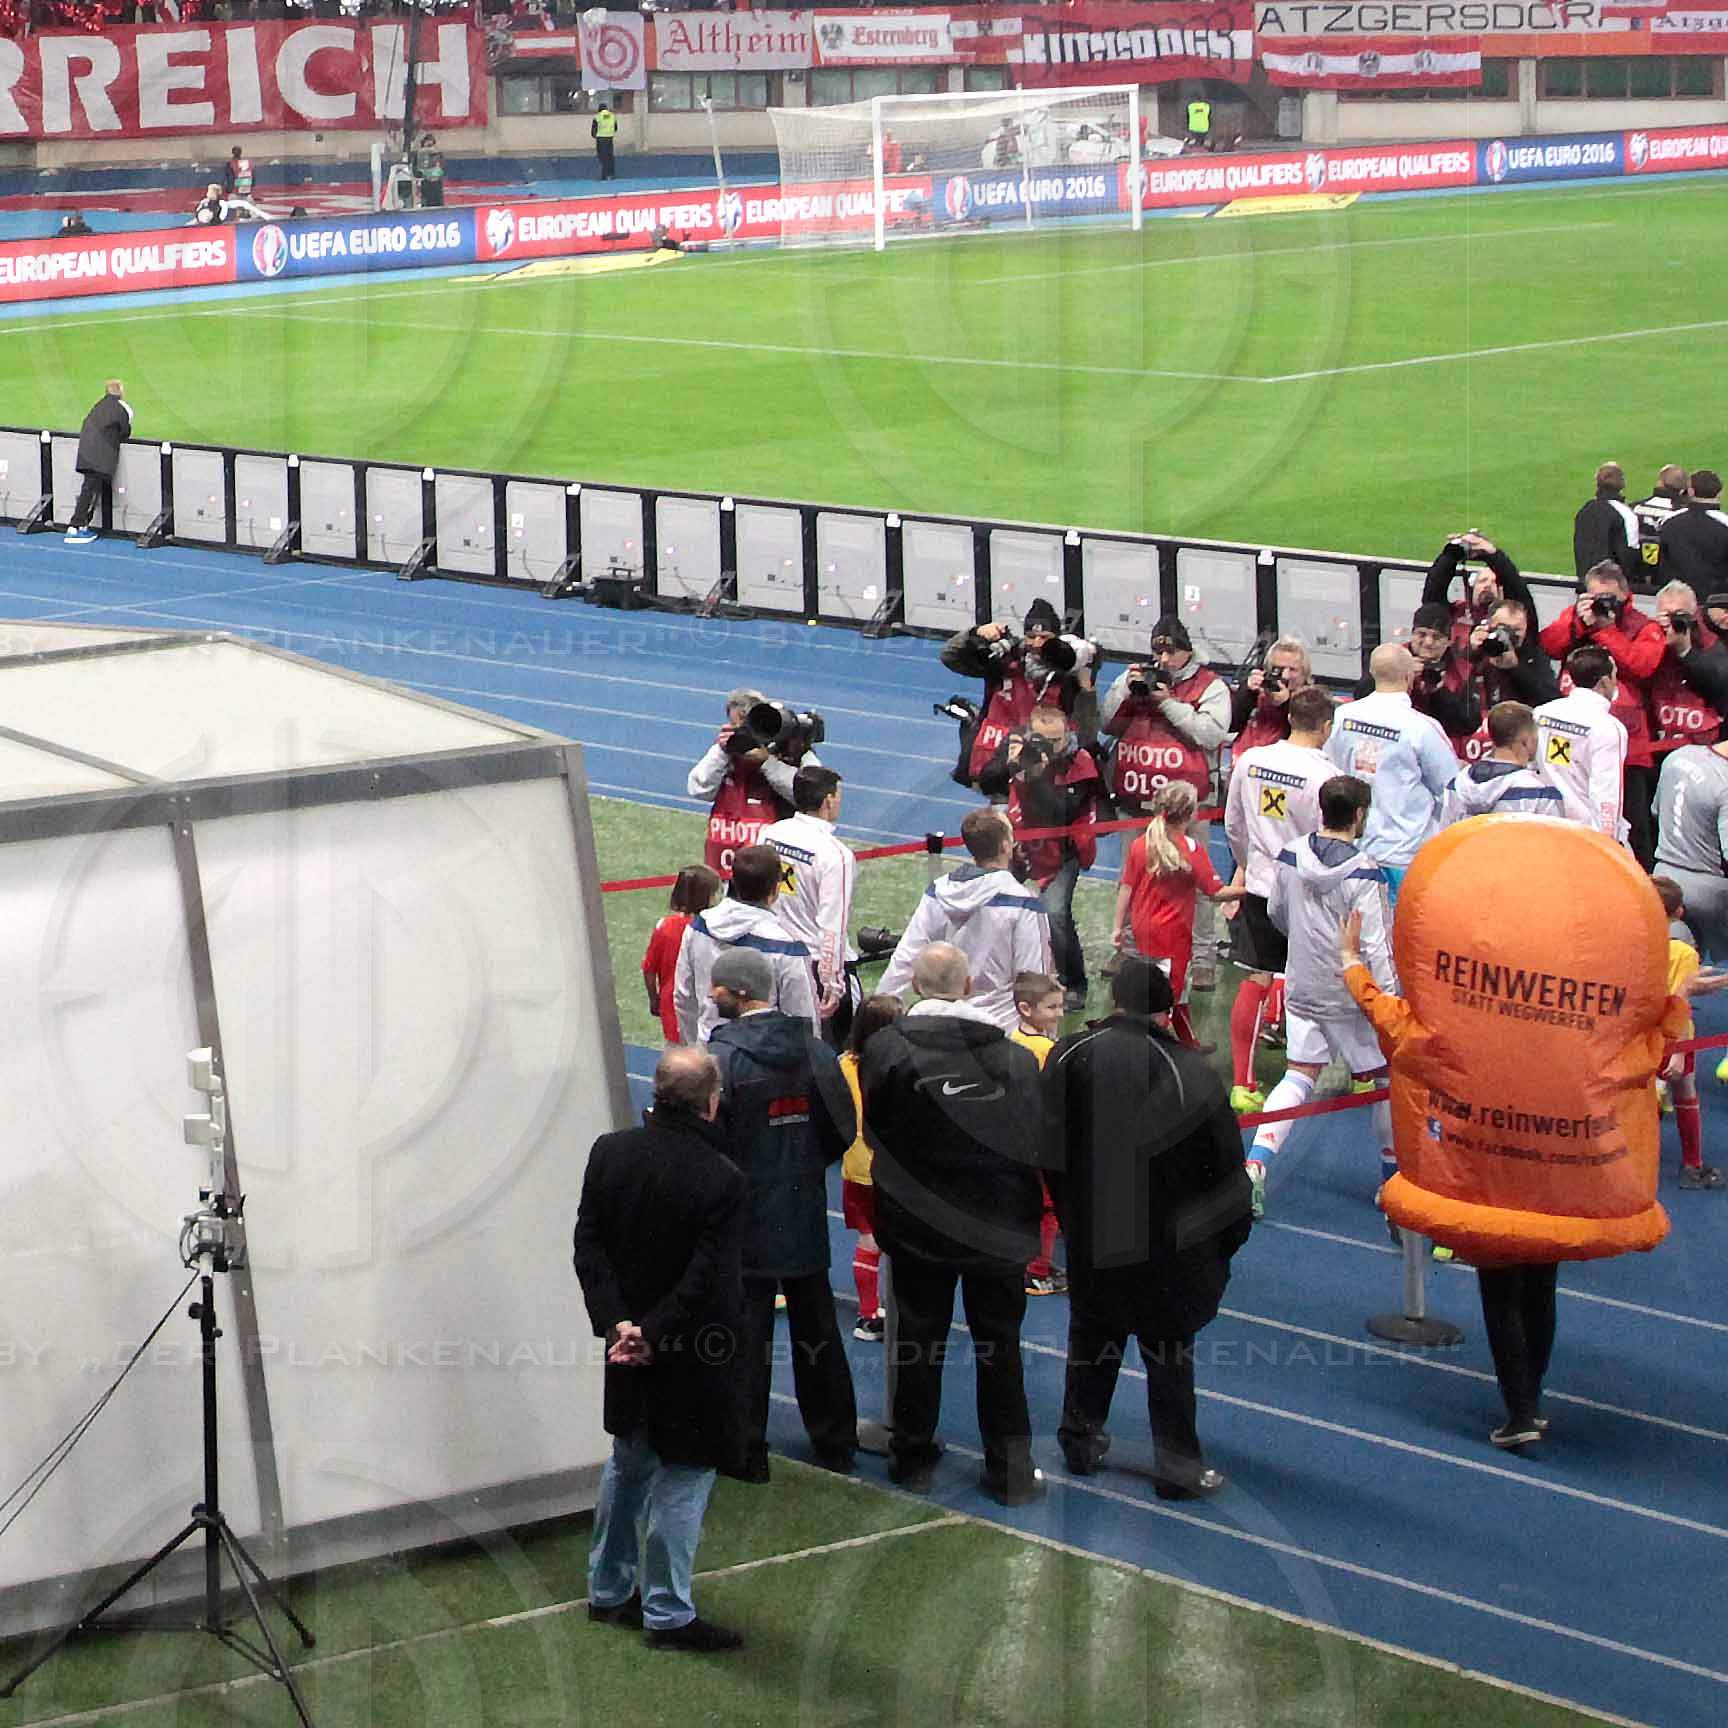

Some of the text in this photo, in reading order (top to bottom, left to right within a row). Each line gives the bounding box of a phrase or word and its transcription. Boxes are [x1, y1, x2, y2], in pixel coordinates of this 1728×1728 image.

[1257, 2, 1604, 34] ATZGERSDOR
[663, 19, 808, 64] Altheim
[1328, 151, 1471, 180] EUROPEAN QUALIFIERS
[1508, 141, 1616, 170] UEFA EURO 2016
[973, 180, 1017, 207] UEFA
[1066, 175, 1106, 200] 2016
[1150, 161, 1302, 193] EUROPEAN QUALIFIERS
[746, 195, 836, 224] EUROPEAN
[290, 222, 462, 260] UEFA EURO 2016
[518, 210, 609, 242] EUROPEAN
[111, 240, 227, 279] QUALIFIERS
[1659, 704, 1704, 730] OTO
[1117, 742, 1184, 769] PHOTO
[1434, 949, 1627, 1017] REINWERFEN
[1451, 986, 1495, 1013] STATT
